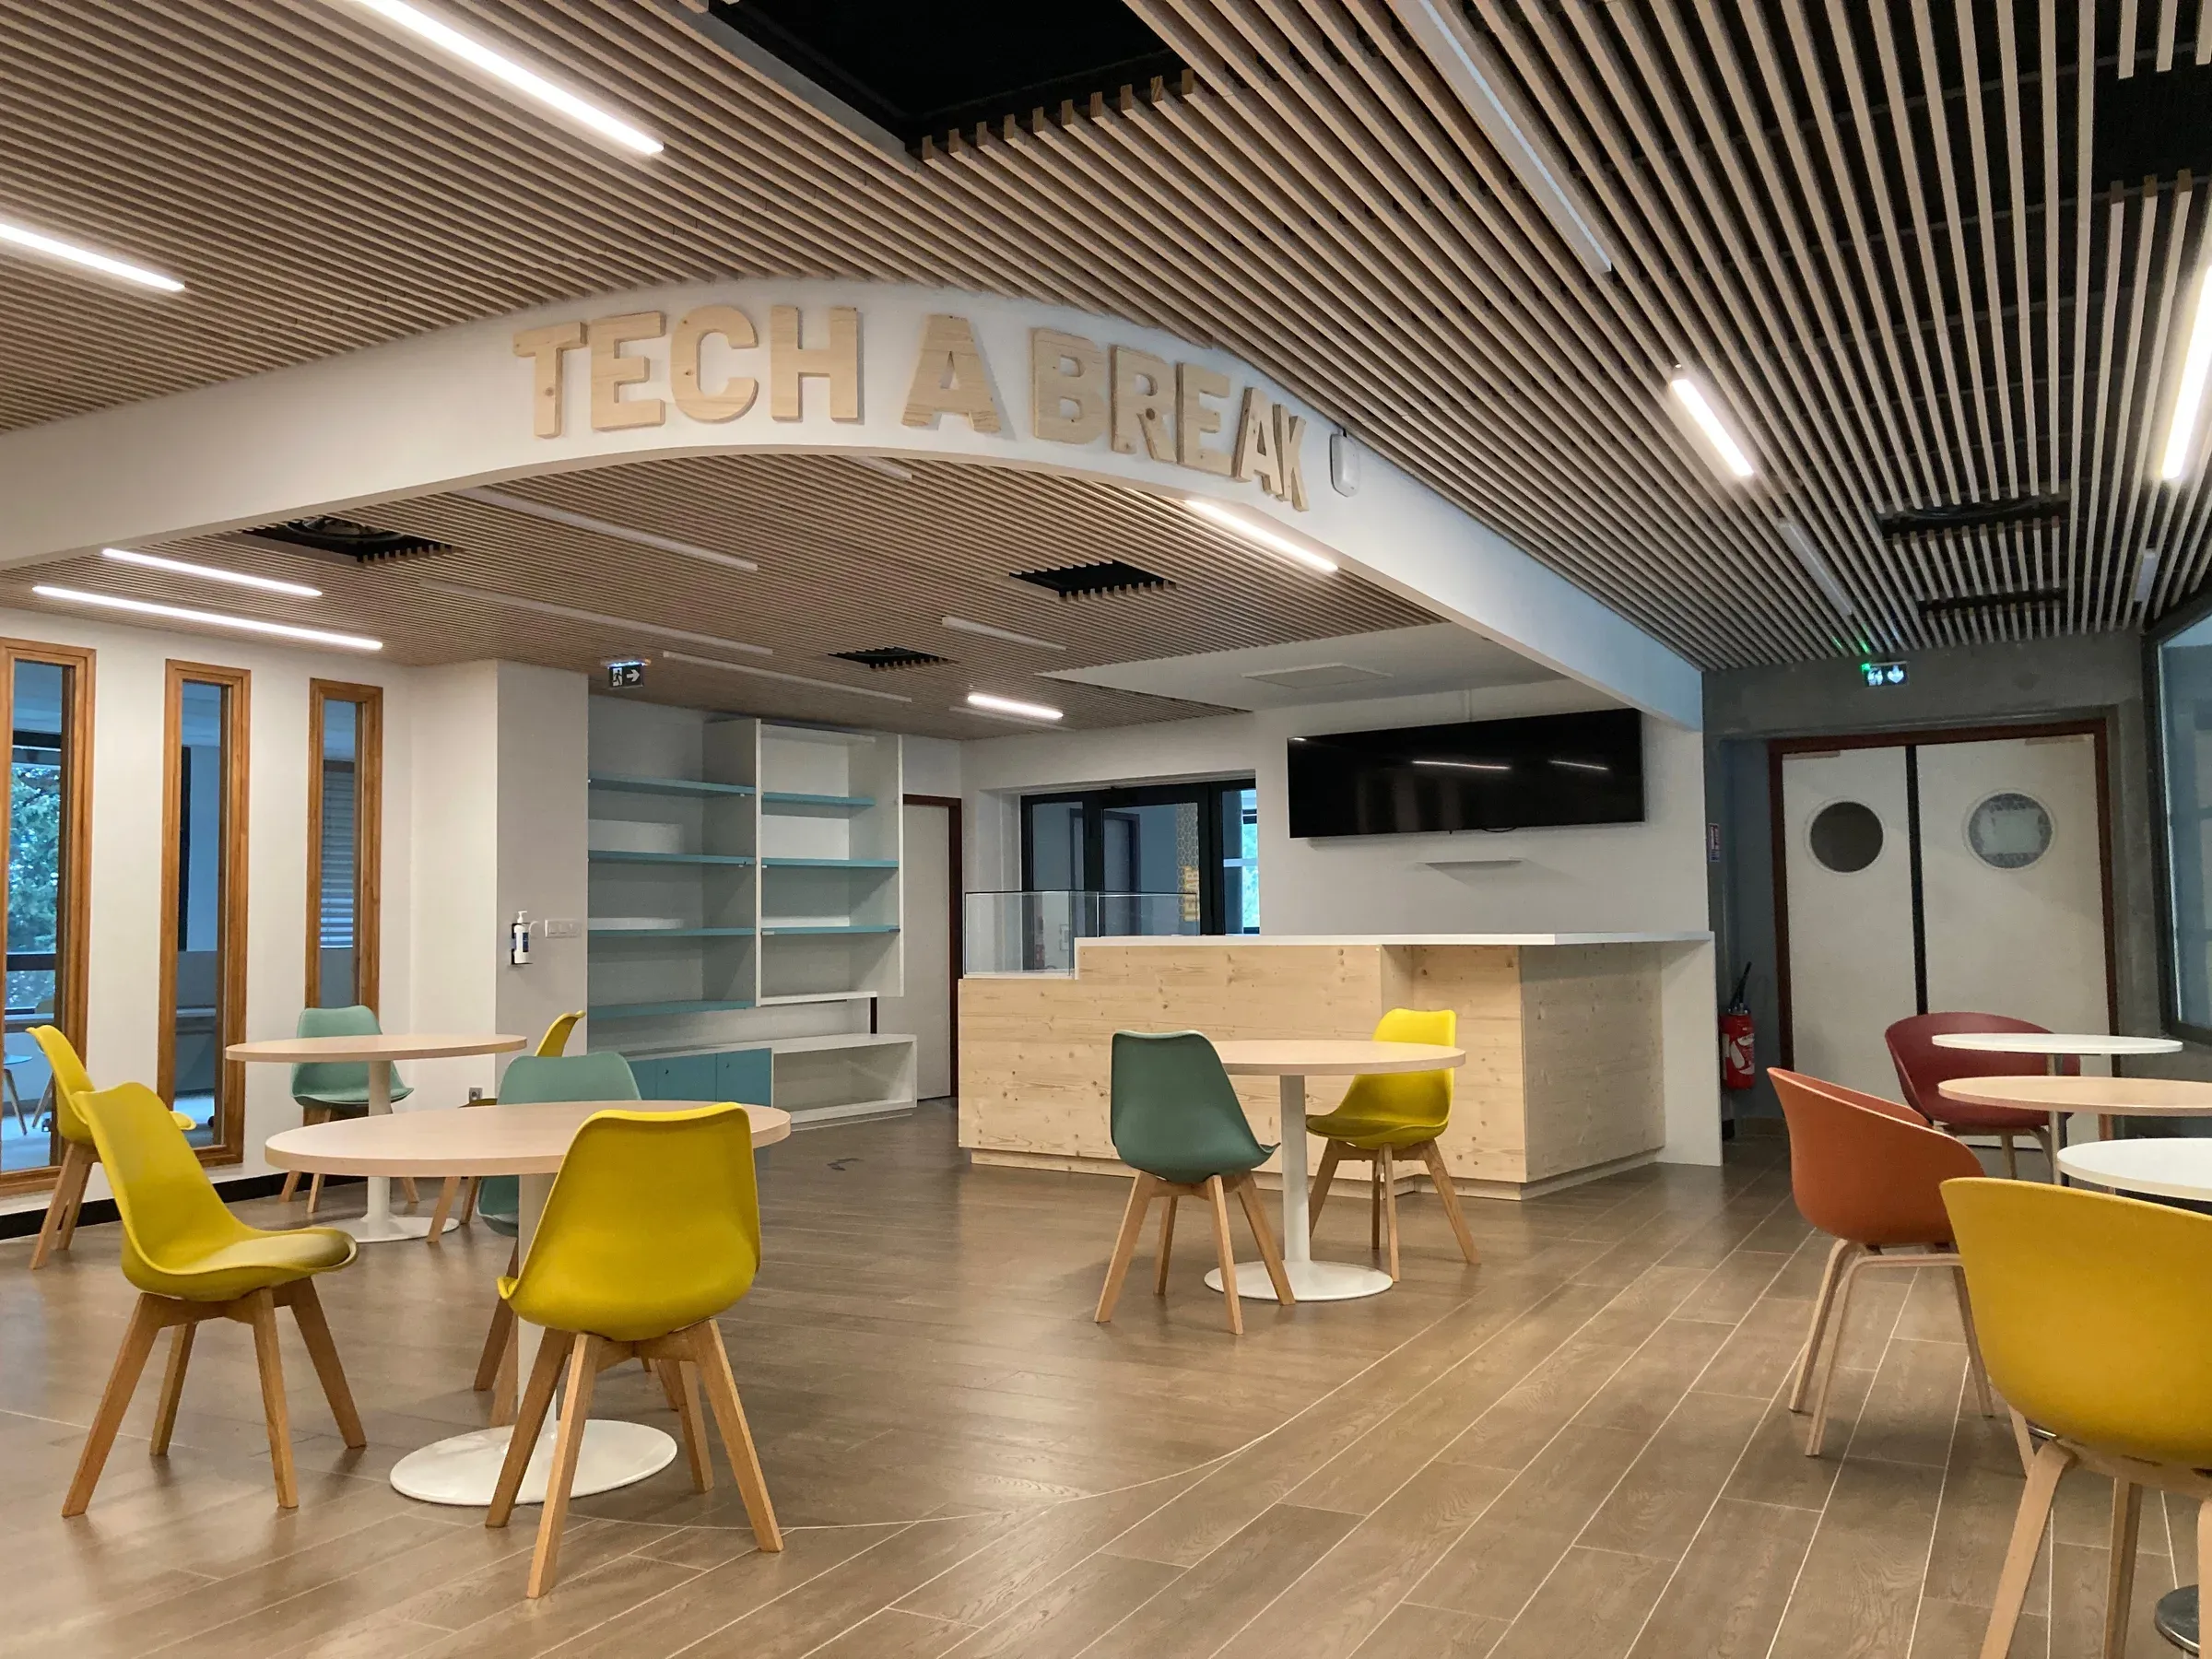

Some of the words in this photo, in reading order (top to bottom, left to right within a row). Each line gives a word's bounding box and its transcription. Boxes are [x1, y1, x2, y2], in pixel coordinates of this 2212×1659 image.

[513, 305, 860, 439] TECH
[900, 313, 1002, 433] A
[1031, 326, 1309, 512] BREAK
